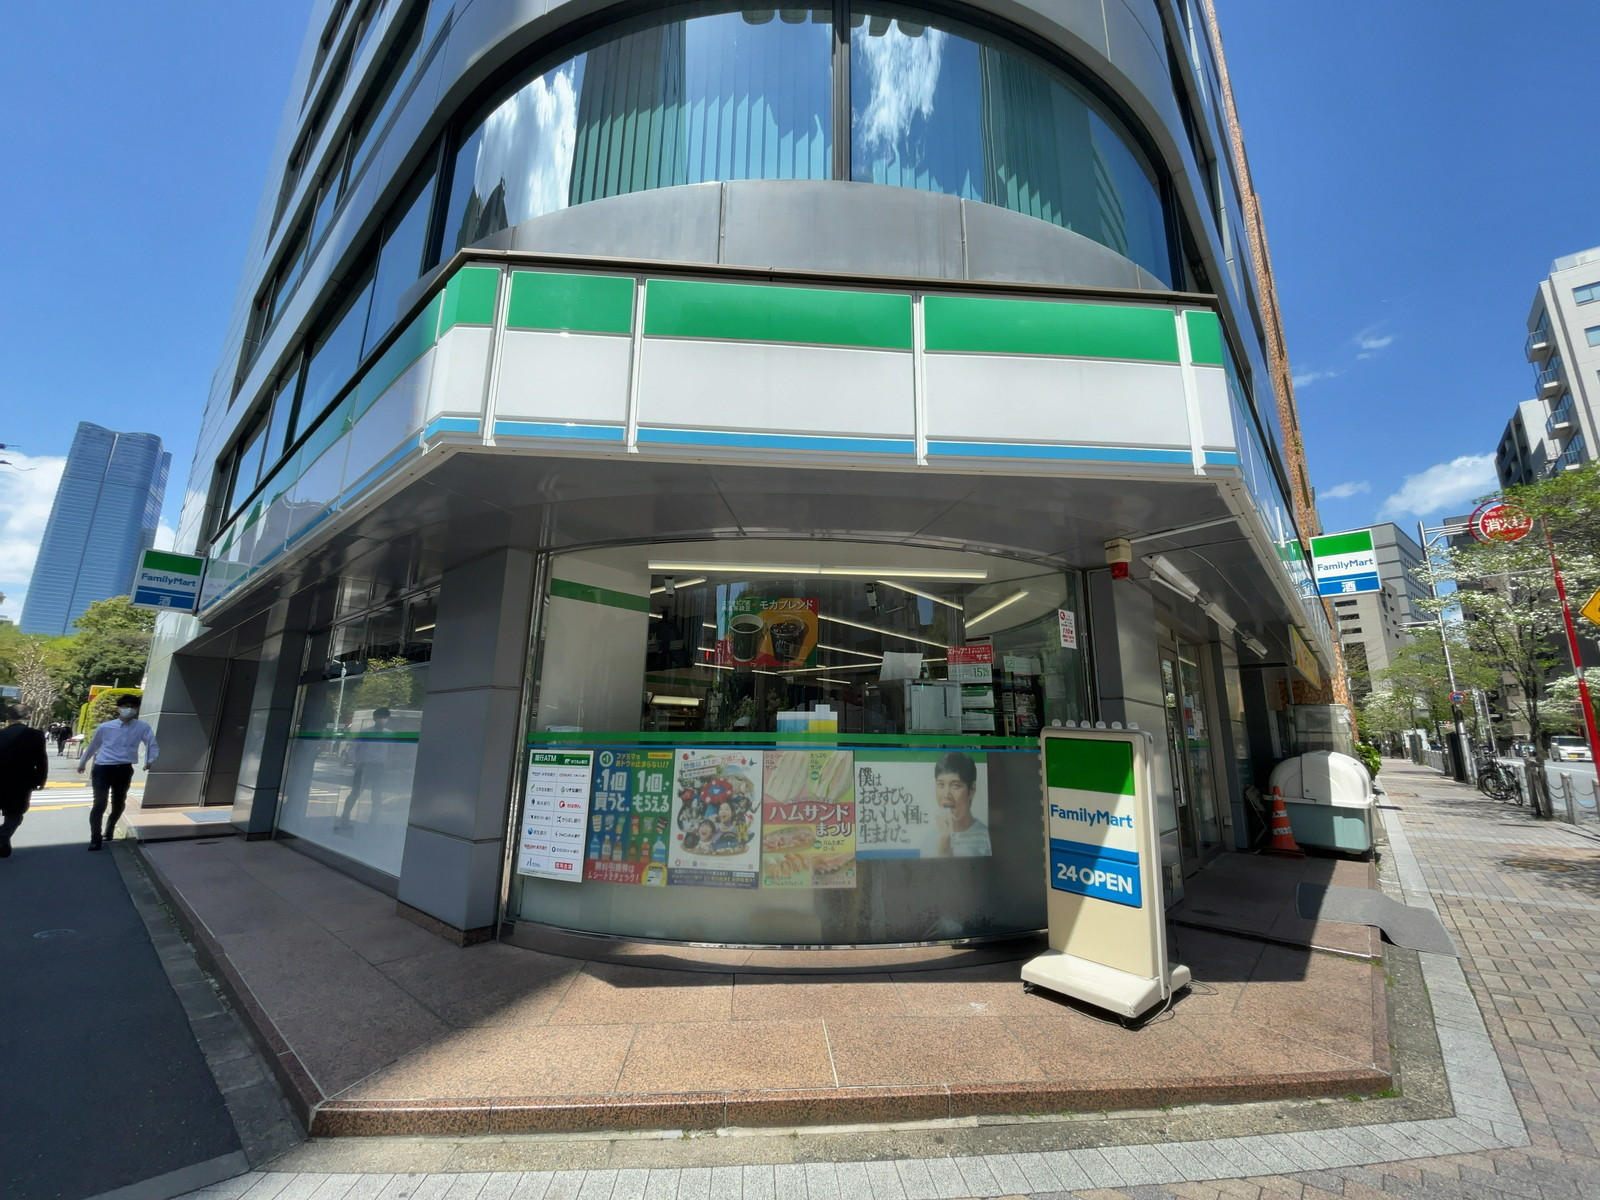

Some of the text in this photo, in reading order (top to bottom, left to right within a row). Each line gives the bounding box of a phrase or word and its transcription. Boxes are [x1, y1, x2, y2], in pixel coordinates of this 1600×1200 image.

[1317, 557, 1374, 571] FamilyMart
[141, 572, 196, 588] FamilyMart
[1341, 580, 1356, 592] 酒
[158, 596, 172, 607] 酒
[760, 600, 813, 610] モカブレンド
[858, 767, 882, 787] 僕は
[633, 794, 669, 813] もらえる
[859, 786, 913, 806] おむすびの
[769, 804, 849, 822] ハムサンド
[859, 805, 928, 825] おいしい国に
[1050, 804, 1133, 828] FamilyMart
[816, 822, 851, 837] まつり
[859, 823, 911, 844] 生まれた。
